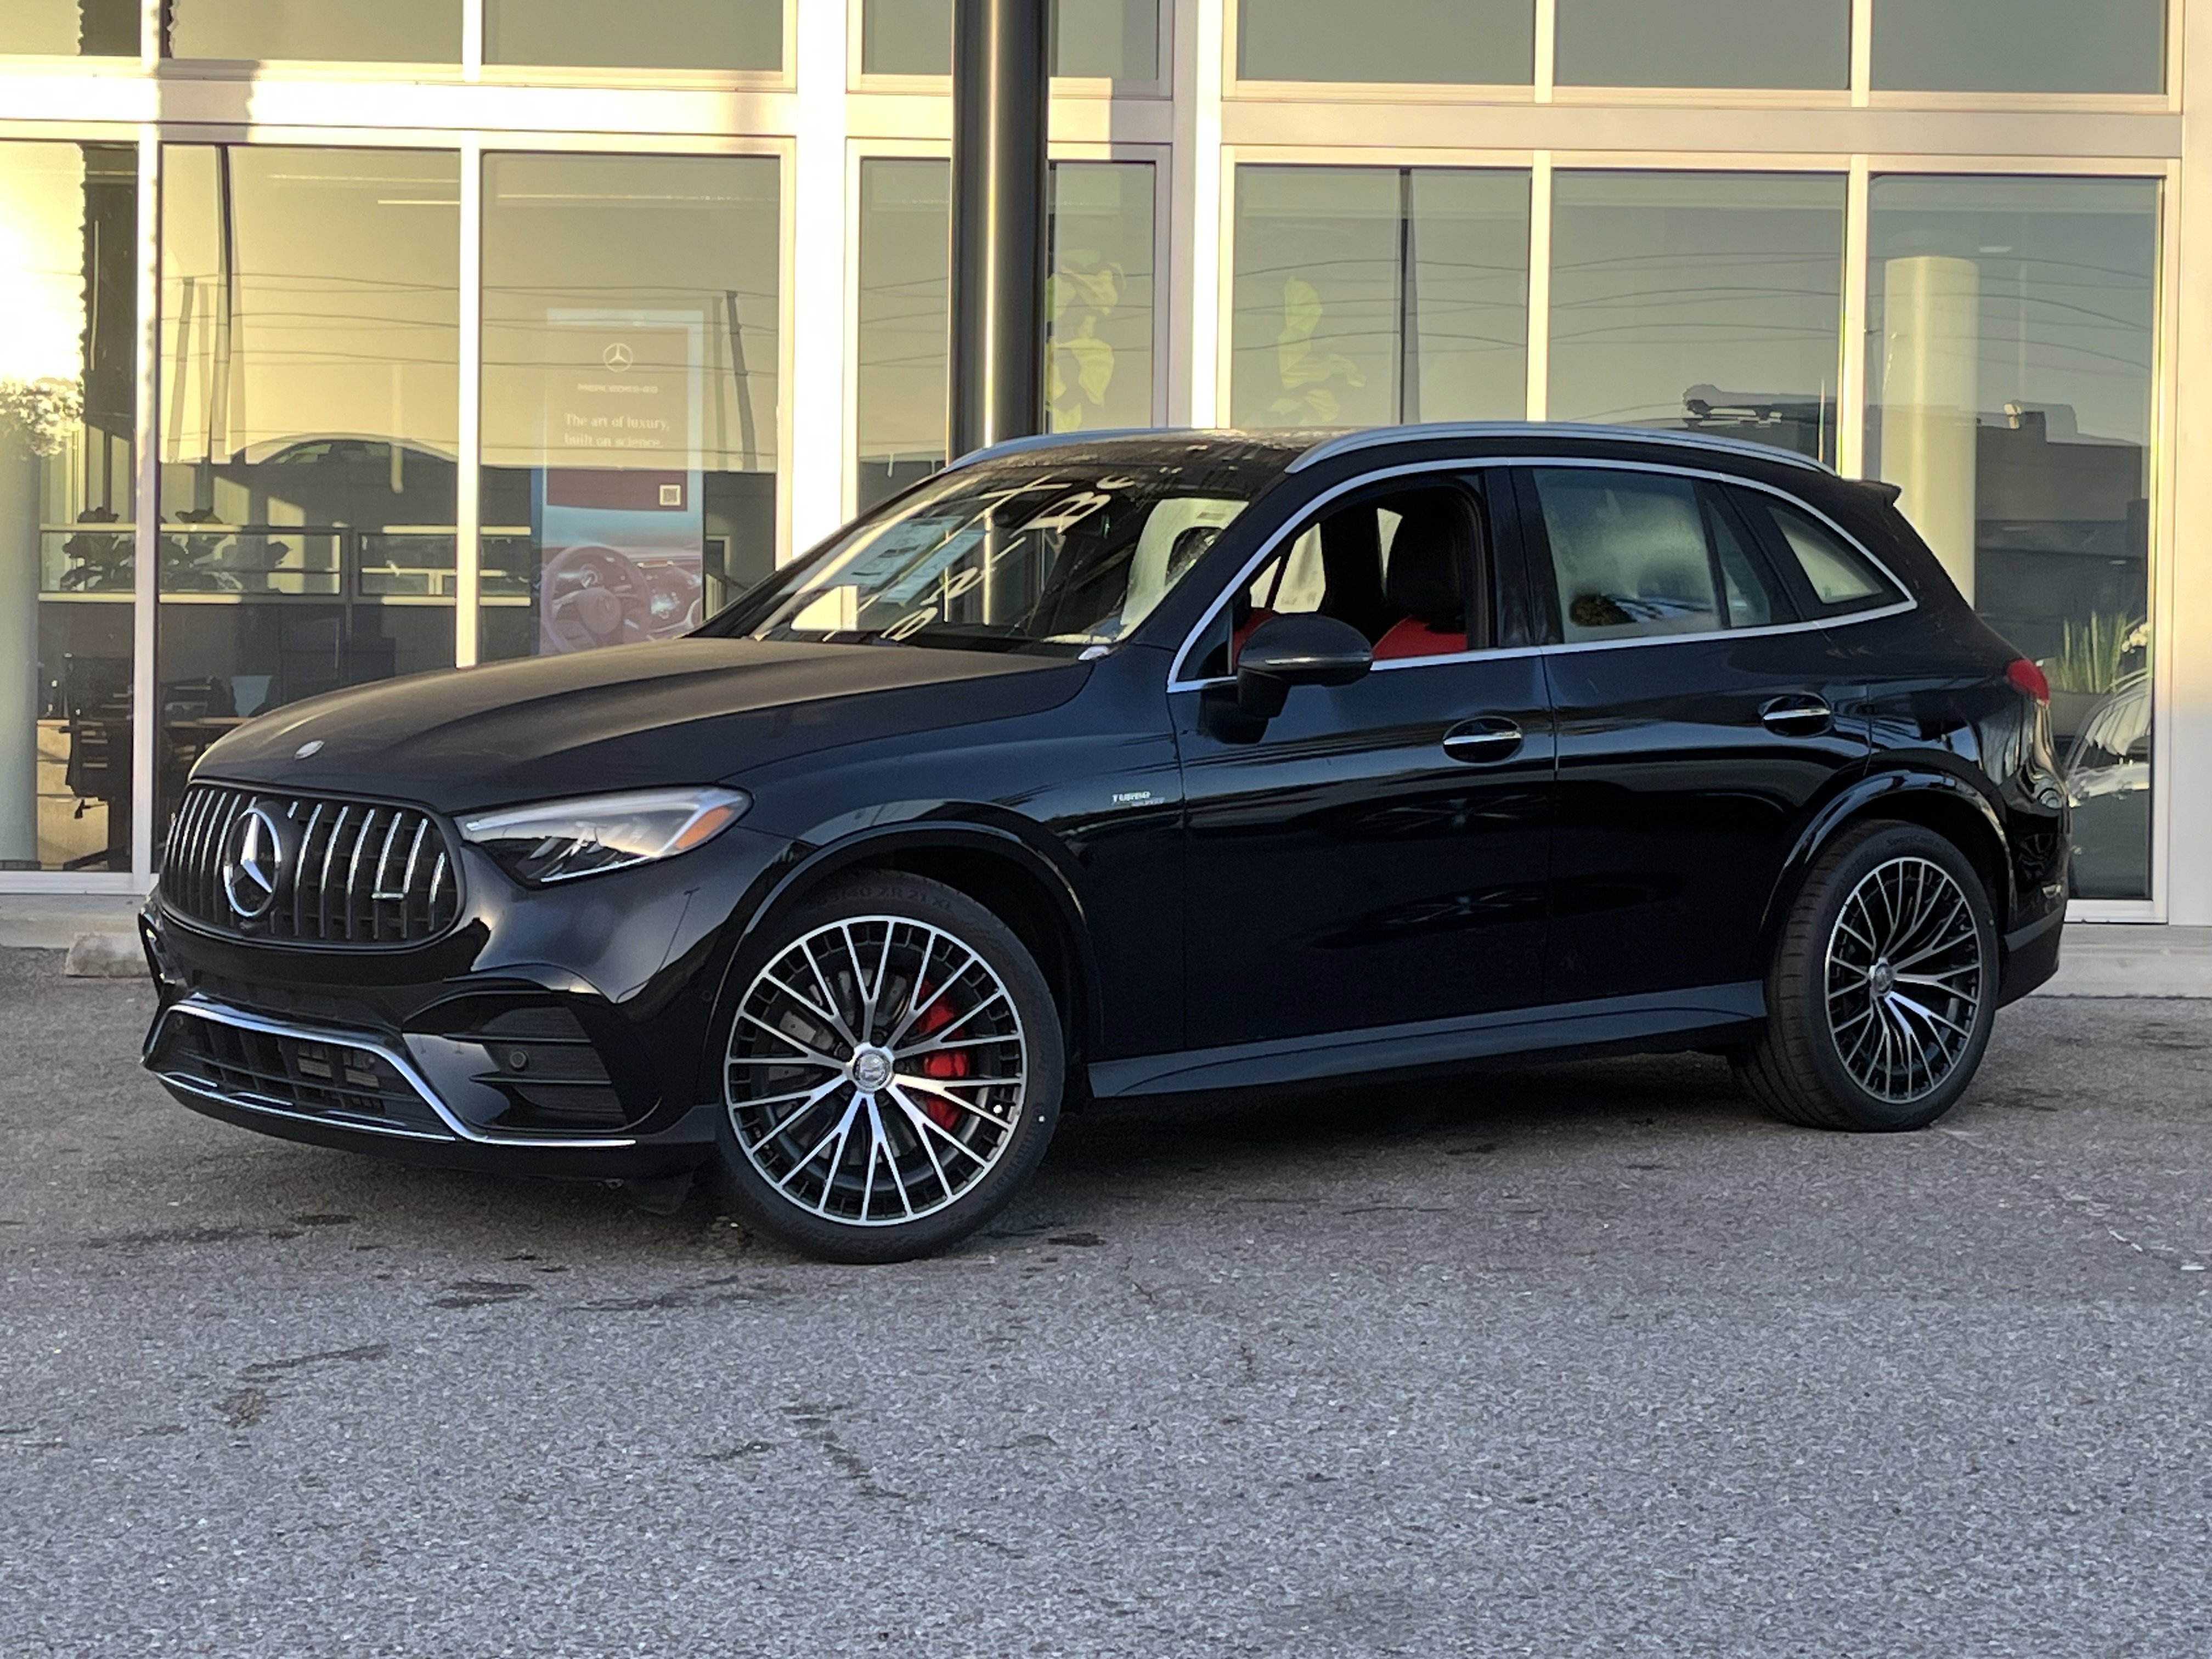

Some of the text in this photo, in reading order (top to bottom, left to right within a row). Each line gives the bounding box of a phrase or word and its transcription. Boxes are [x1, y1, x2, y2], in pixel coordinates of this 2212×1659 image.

[565, 413, 670, 433] The art of luxury,
[564, 432, 663, 449] built on science.
